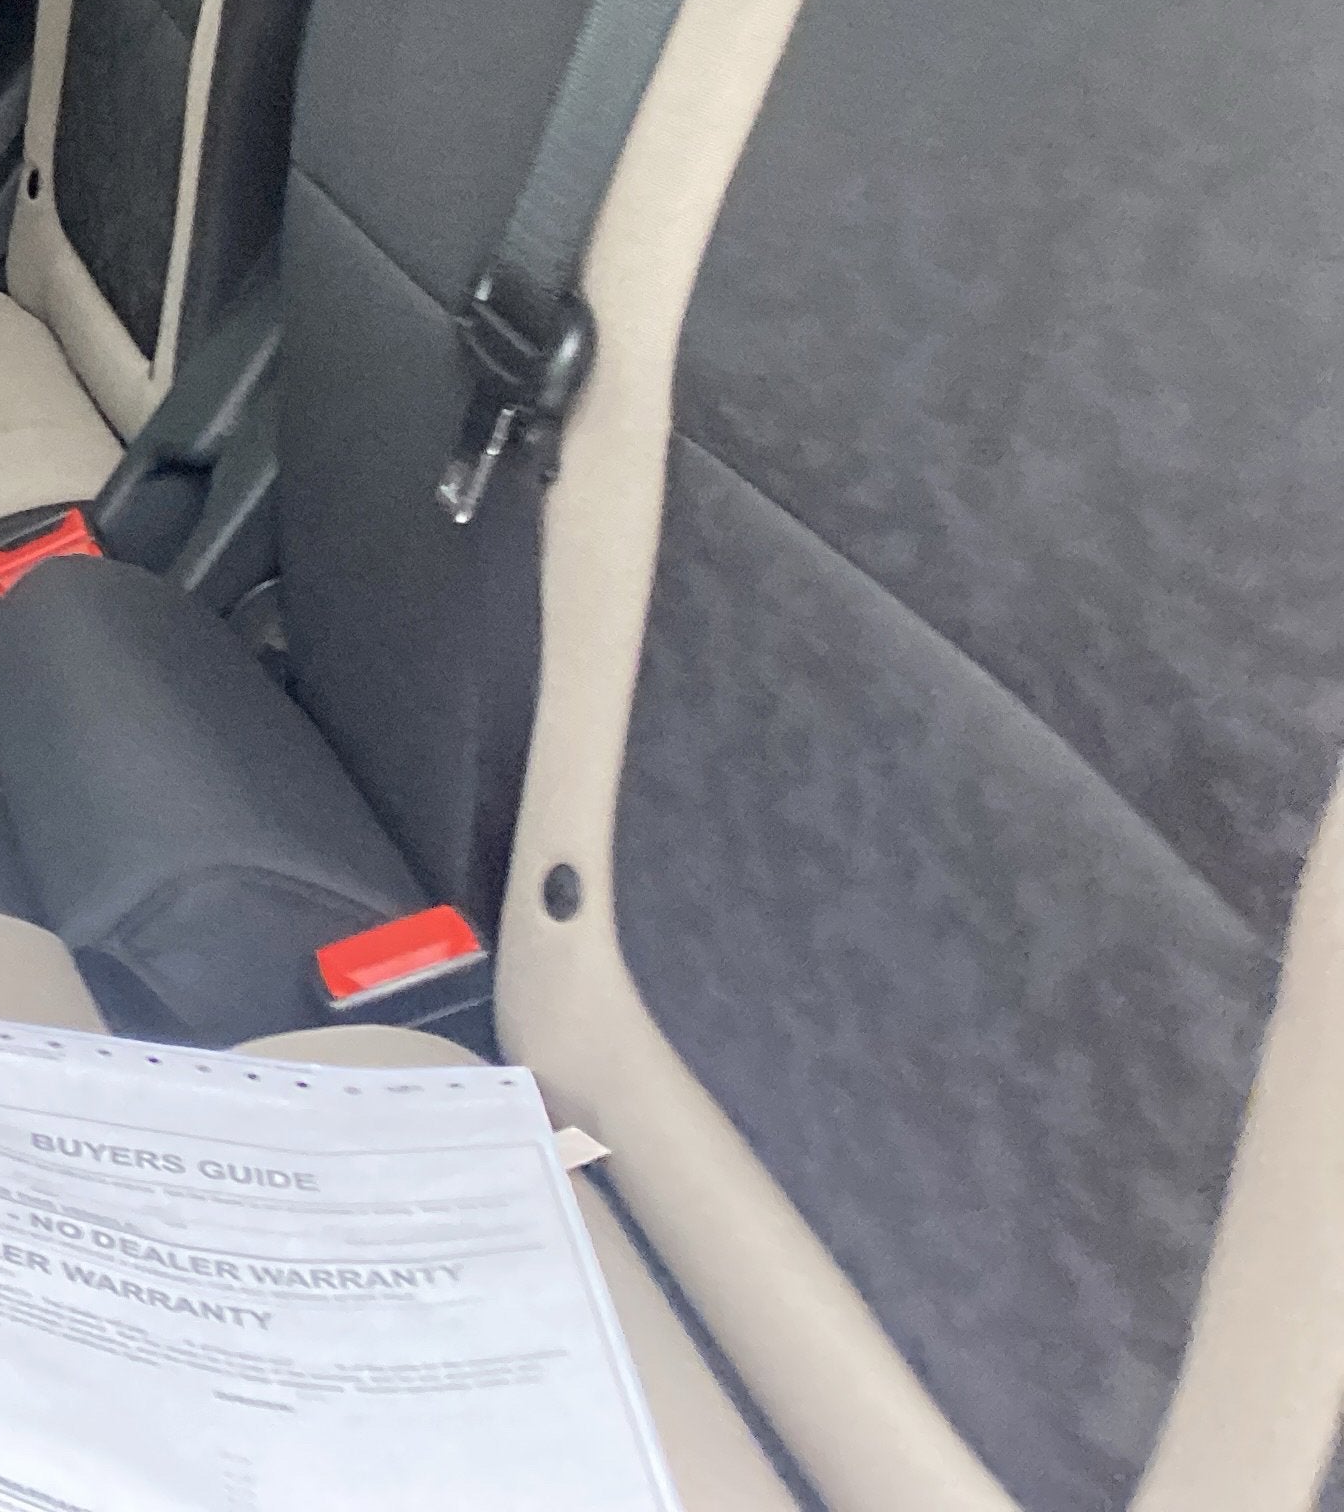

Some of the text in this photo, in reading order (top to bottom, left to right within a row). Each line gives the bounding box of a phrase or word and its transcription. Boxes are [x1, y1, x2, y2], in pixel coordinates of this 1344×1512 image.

[30, 1131, 187, 1175] BUYERS
[196, 1158, 321, 1192] GUIDE
[29, 1212, 84, 1240] NO
[90, 1229, 241, 1283] DEALER
[247, 1261, 464, 1290] WARRANTY
[60, 1261, 273, 1331] WARRANTY
